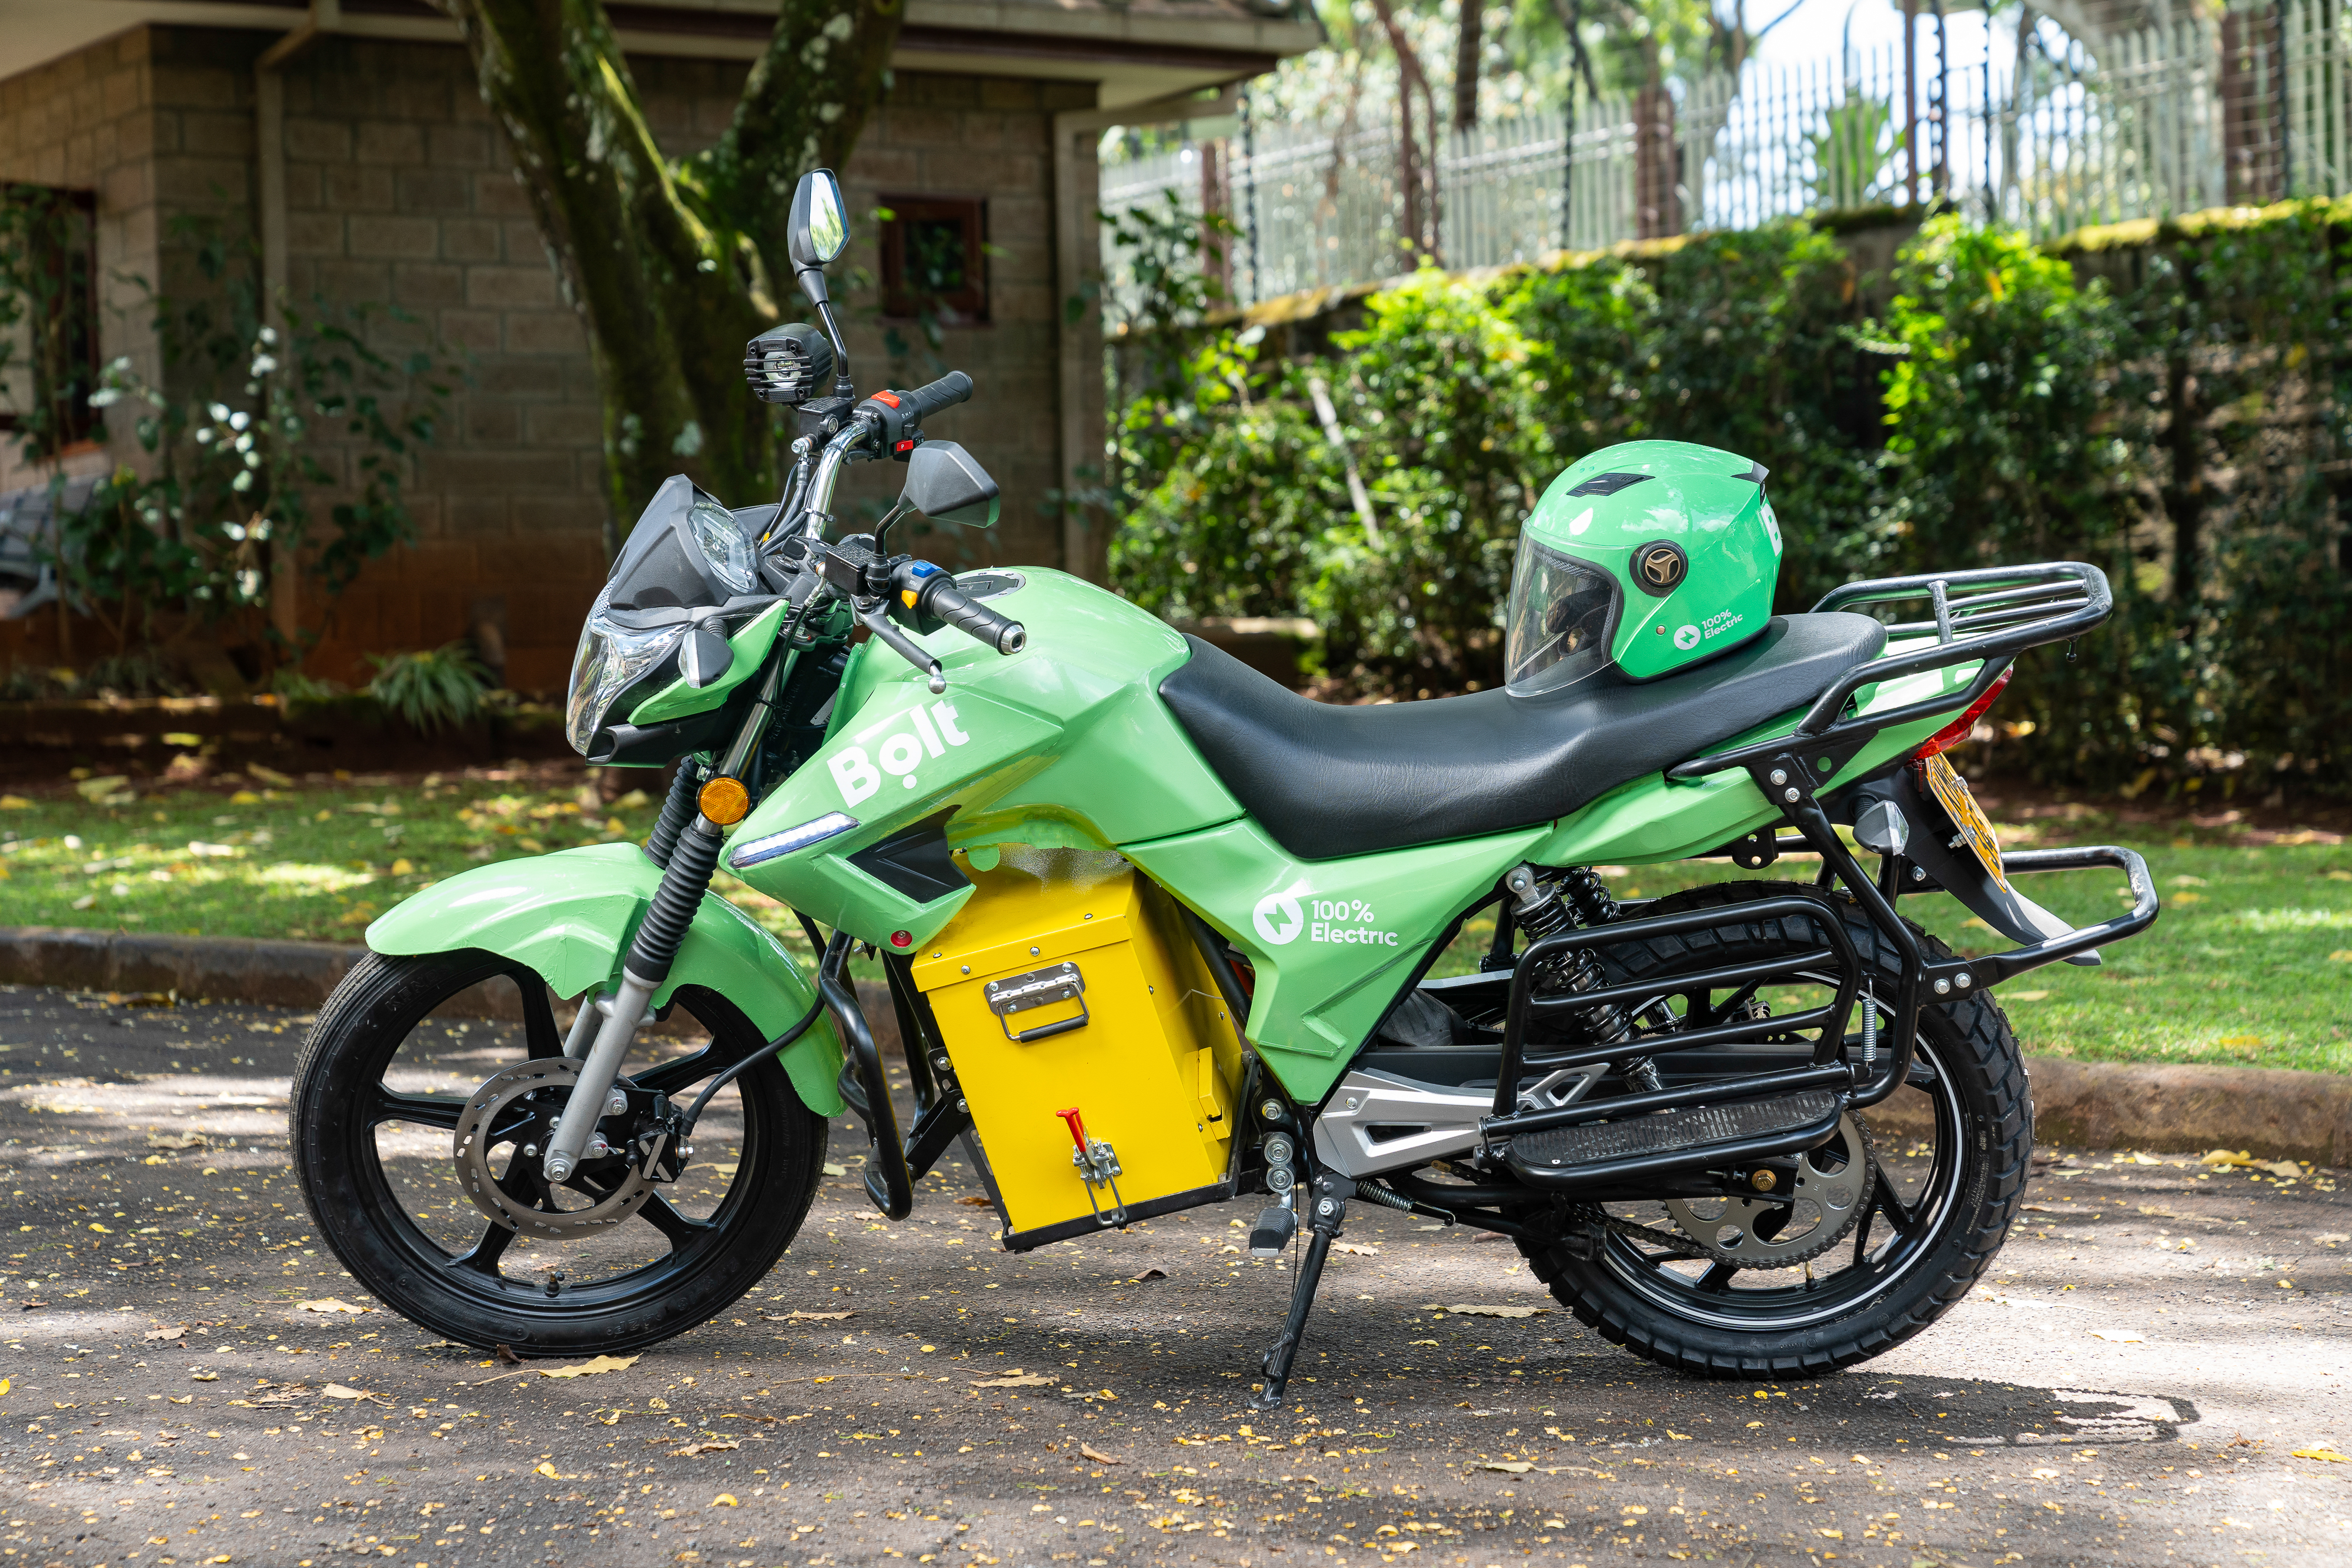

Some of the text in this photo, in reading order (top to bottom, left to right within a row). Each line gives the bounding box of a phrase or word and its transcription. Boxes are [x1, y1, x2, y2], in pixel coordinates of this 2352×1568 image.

[1701, 609, 1732, 630] 100%
[1704, 614, 1743, 640] Electric
[826, 699, 971, 809] Bolt
[1311, 899, 1374, 922] 100%
[1311, 922, 1398, 947] Electric
